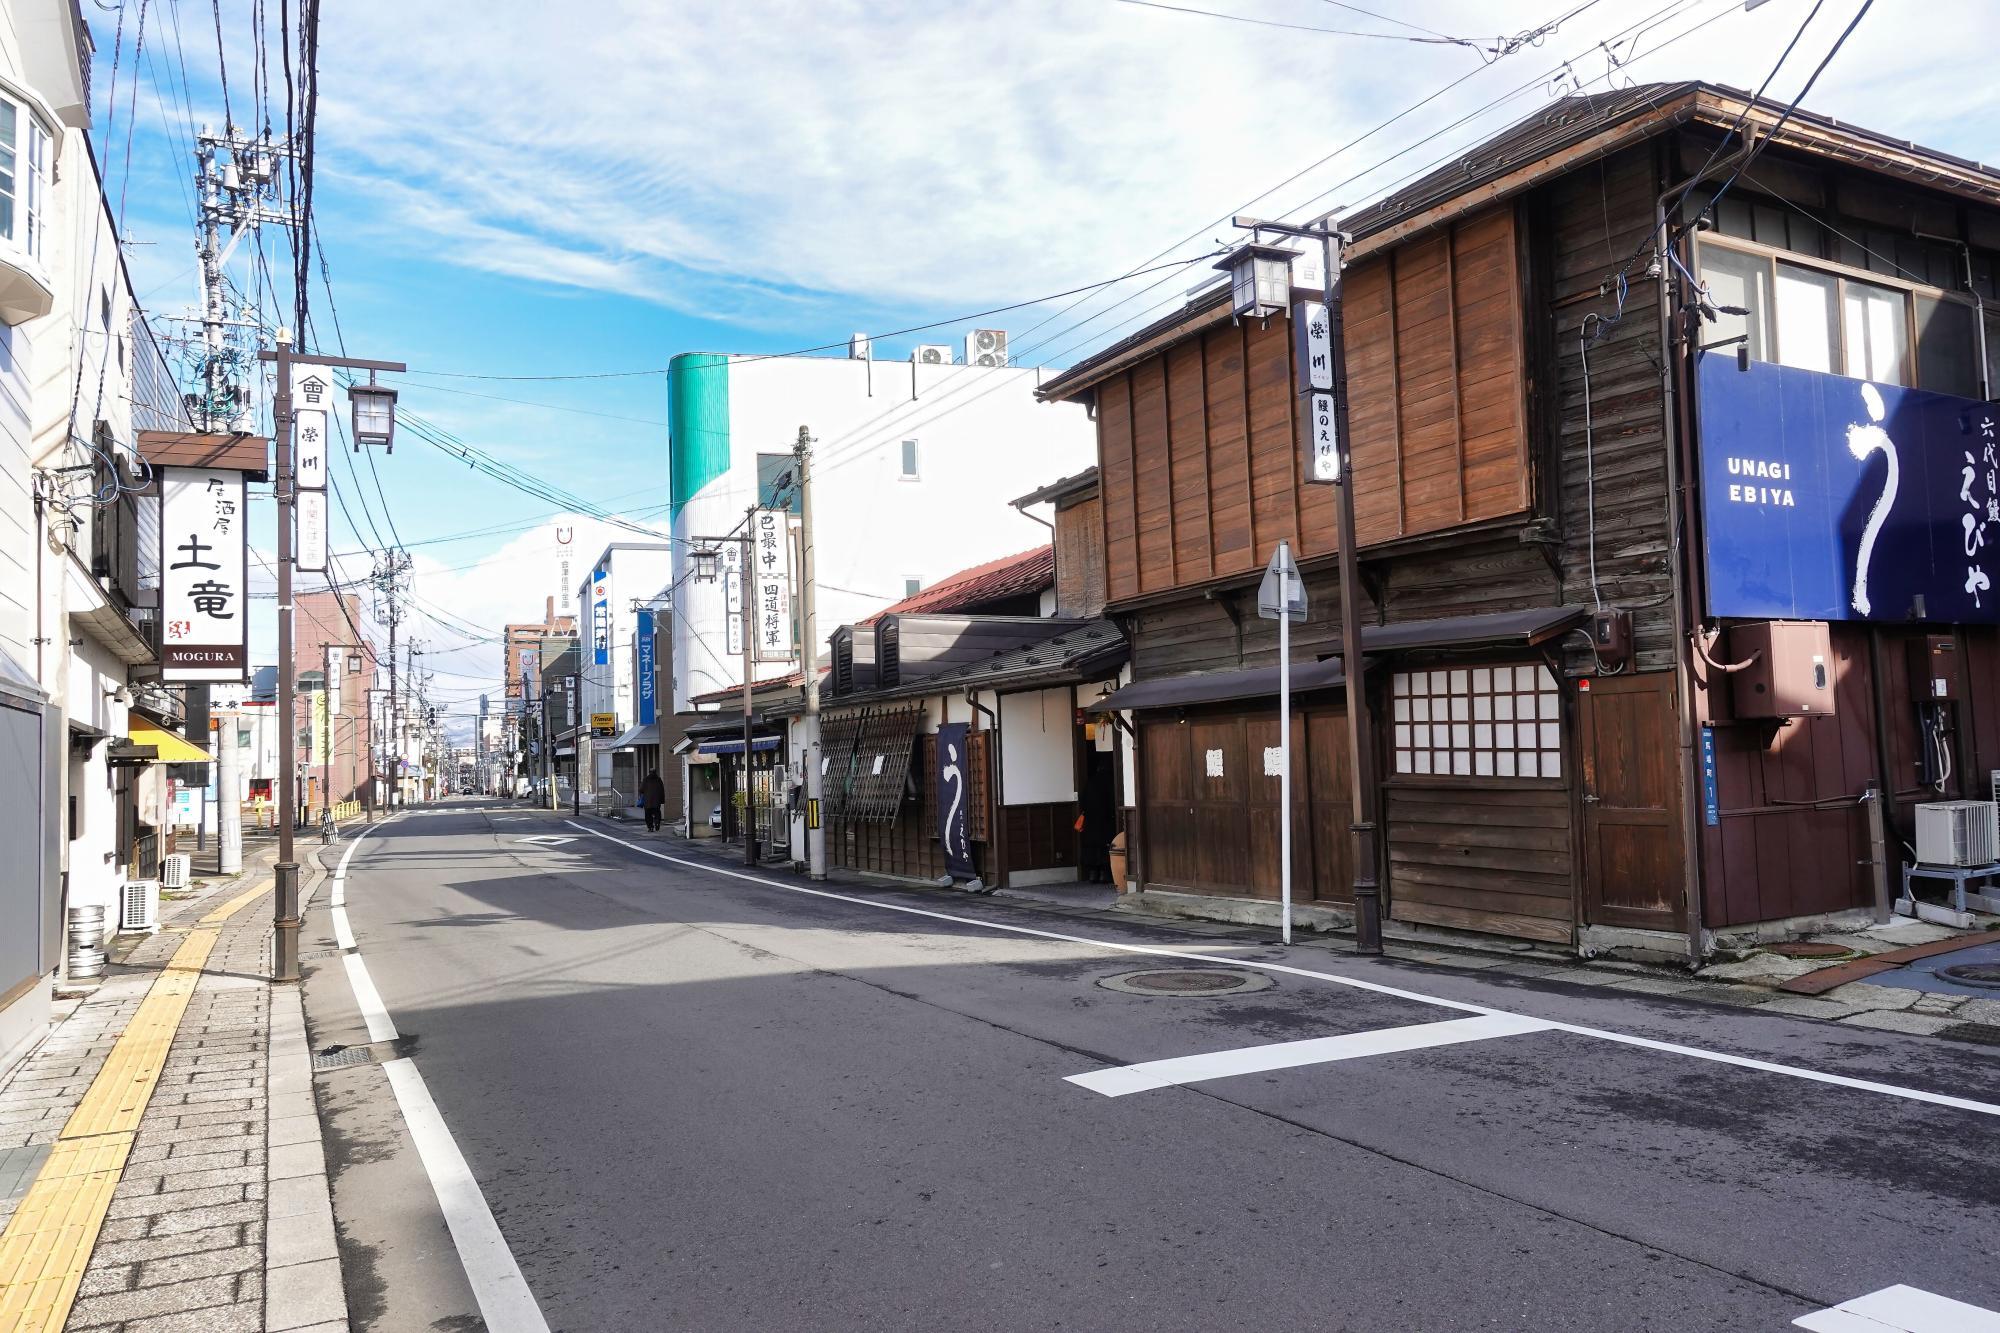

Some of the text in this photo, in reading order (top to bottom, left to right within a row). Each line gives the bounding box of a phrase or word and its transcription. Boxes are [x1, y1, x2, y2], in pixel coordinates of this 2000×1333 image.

[1318, 399, 1331, 473] 鰻のえびや
[1728, 457, 1790, 480] UNAGI
[1729, 484, 1795, 506] EBIYA
[207, 478, 235, 535] 居酒屋
[1960, 451, 1991, 609] えびや
[761, 515, 777, 570] 巴最中
[170, 533, 234, 620] 土竜
[172, 652, 234, 661] MOGURA
